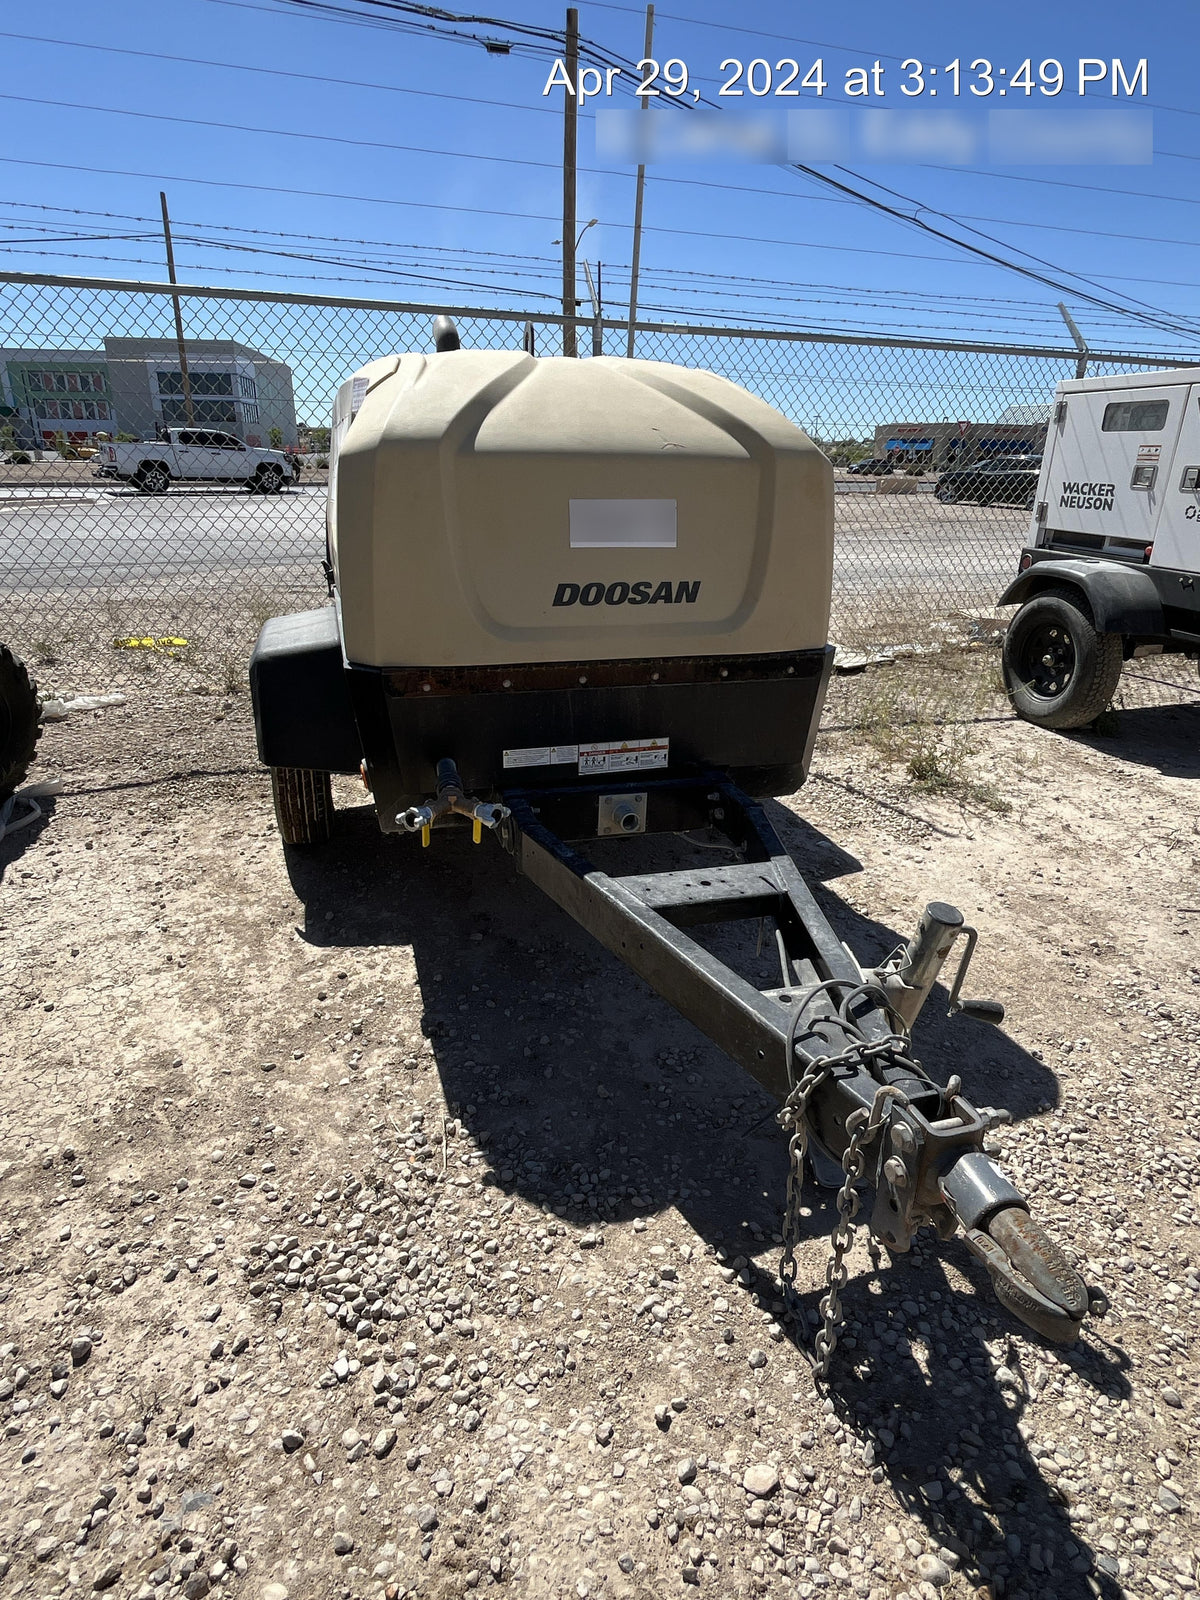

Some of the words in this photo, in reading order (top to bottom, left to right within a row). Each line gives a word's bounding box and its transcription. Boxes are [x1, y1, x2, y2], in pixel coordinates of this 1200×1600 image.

[1062, 481, 1116, 498] WACKER
[1059, 495, 1114, 512] NEUSON
[552, 581, 702, 607] DOOSAN
